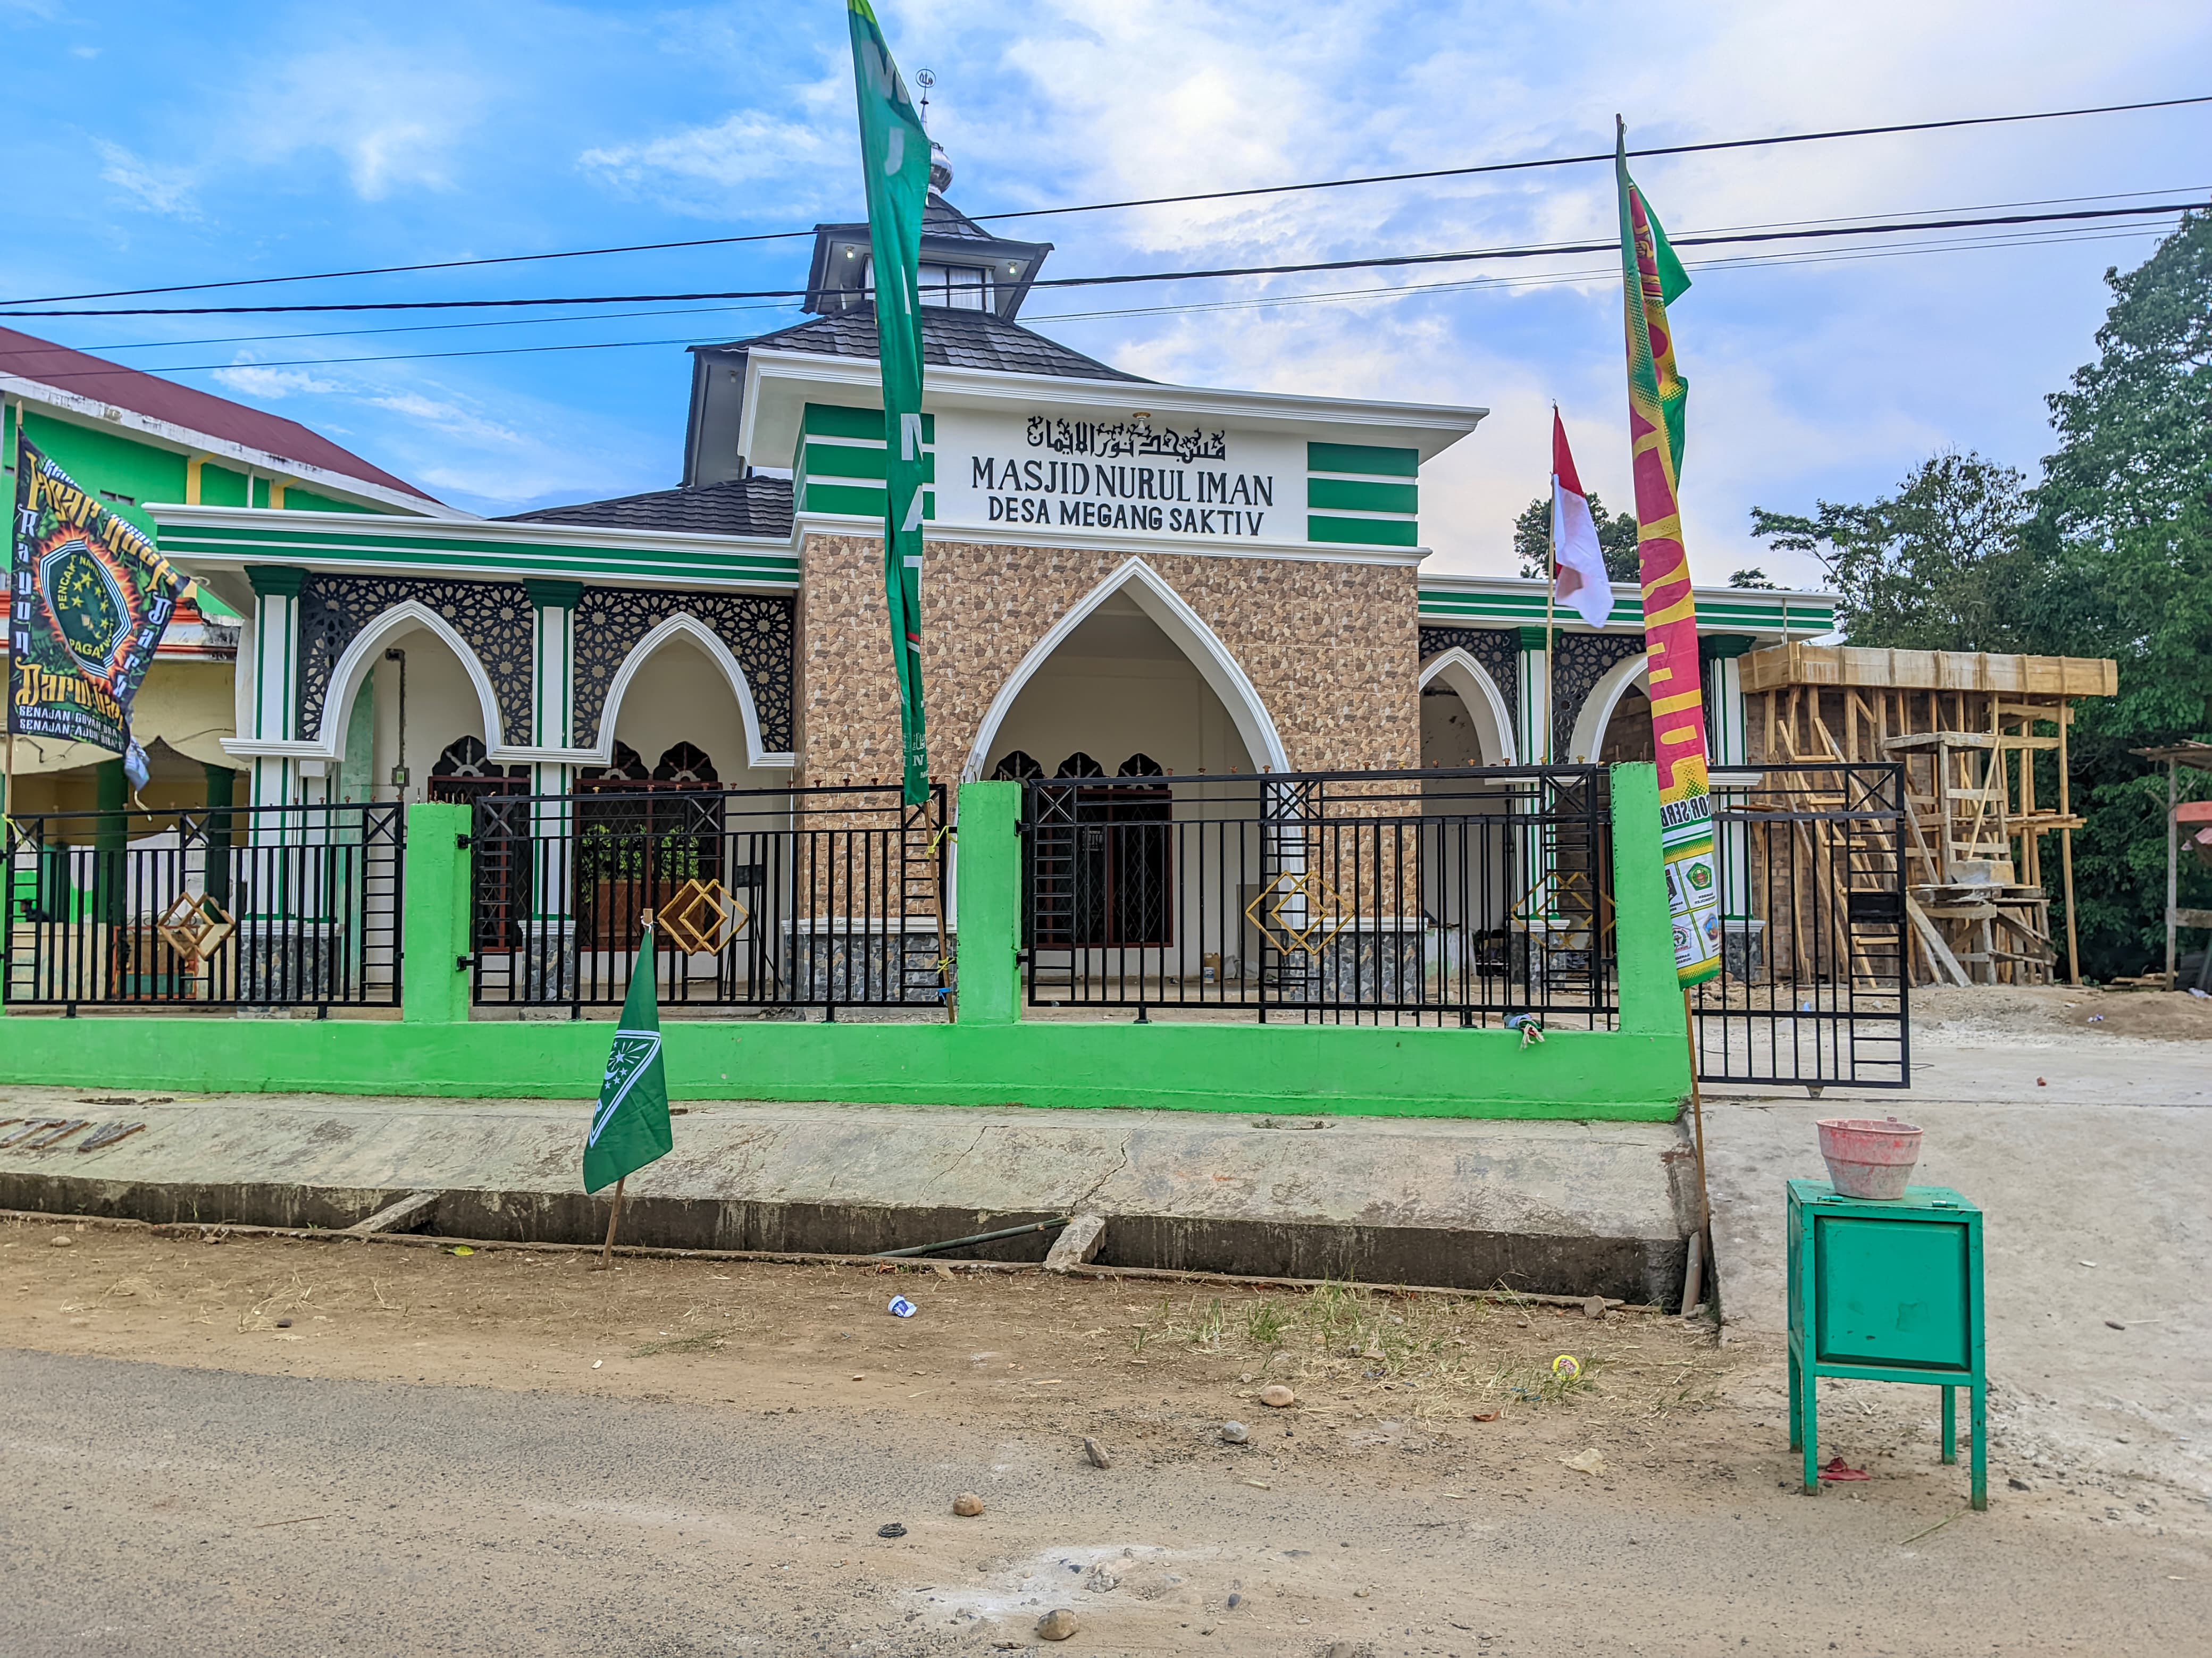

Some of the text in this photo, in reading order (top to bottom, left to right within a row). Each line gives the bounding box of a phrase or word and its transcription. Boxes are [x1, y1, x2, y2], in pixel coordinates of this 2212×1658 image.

[971, 456, 1273, 507] MASJID NURUL IMAN
[988, 496, 1051, 524] DESA
[1059, 500, 1162, 531] MEGANG
[19, 705, 71, 721] SENAJAN
[20, 719, 70, 734] SENAJAN
